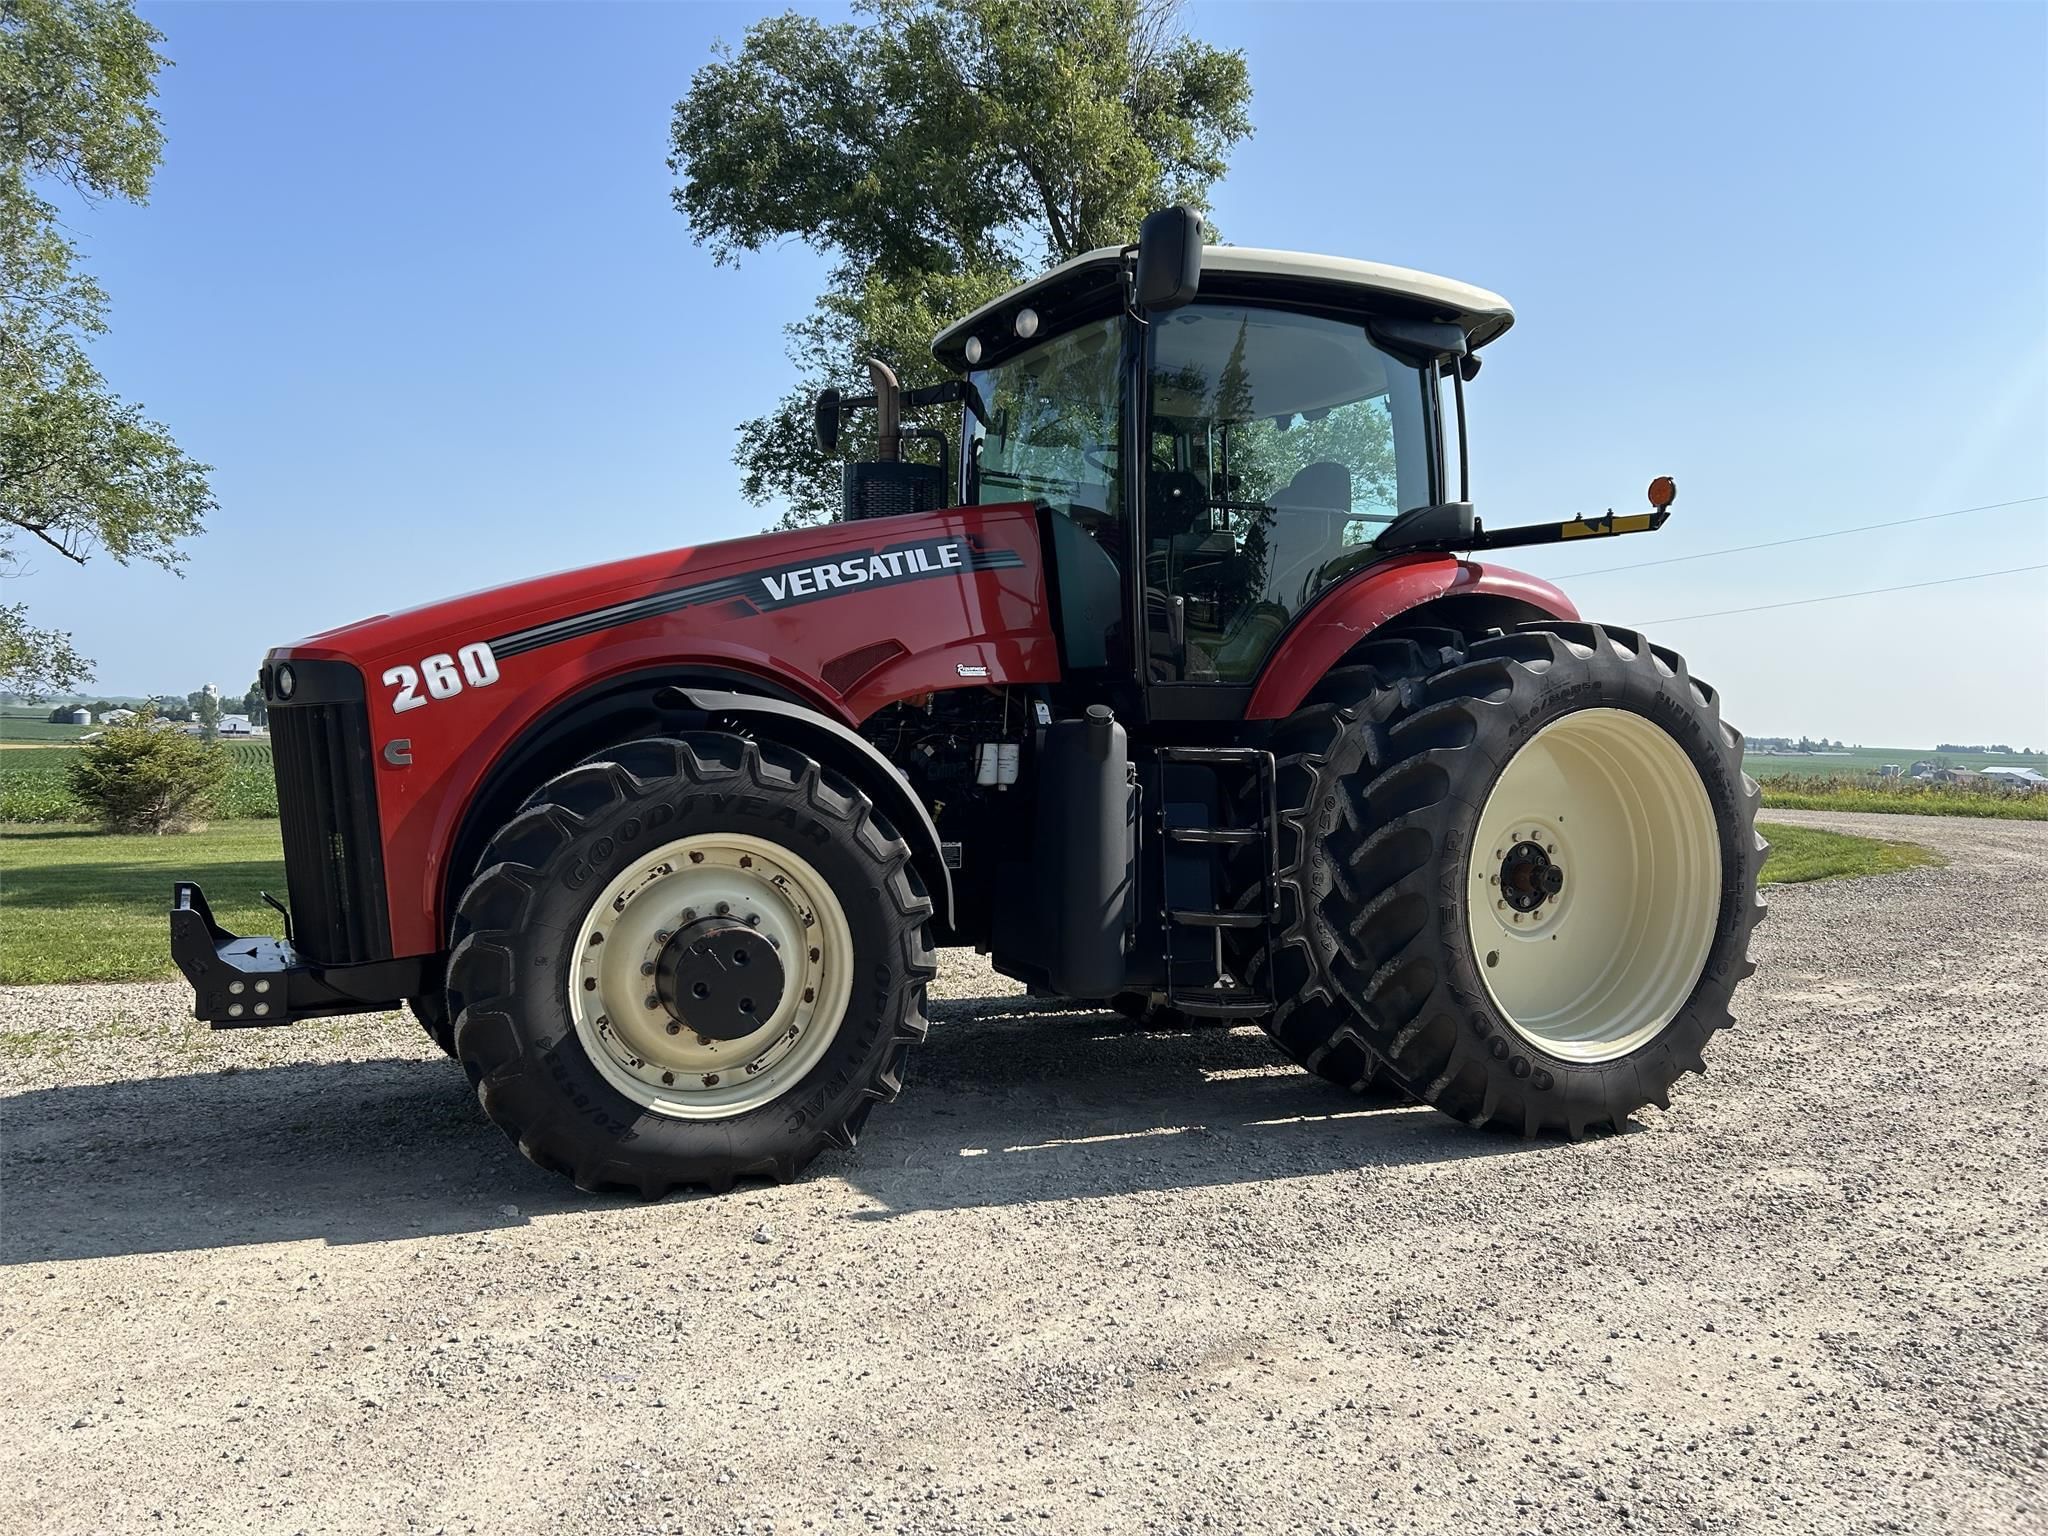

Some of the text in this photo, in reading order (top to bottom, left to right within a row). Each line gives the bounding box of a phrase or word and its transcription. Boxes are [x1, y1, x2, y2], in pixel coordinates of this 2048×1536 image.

[761, 543, 962, 601] VERSATILE
[382, 641, 500, 714] 260
[563, 793, 833, 891] GOODYEAR
[1438, 828, 1555, 1091] GOODYEAR
